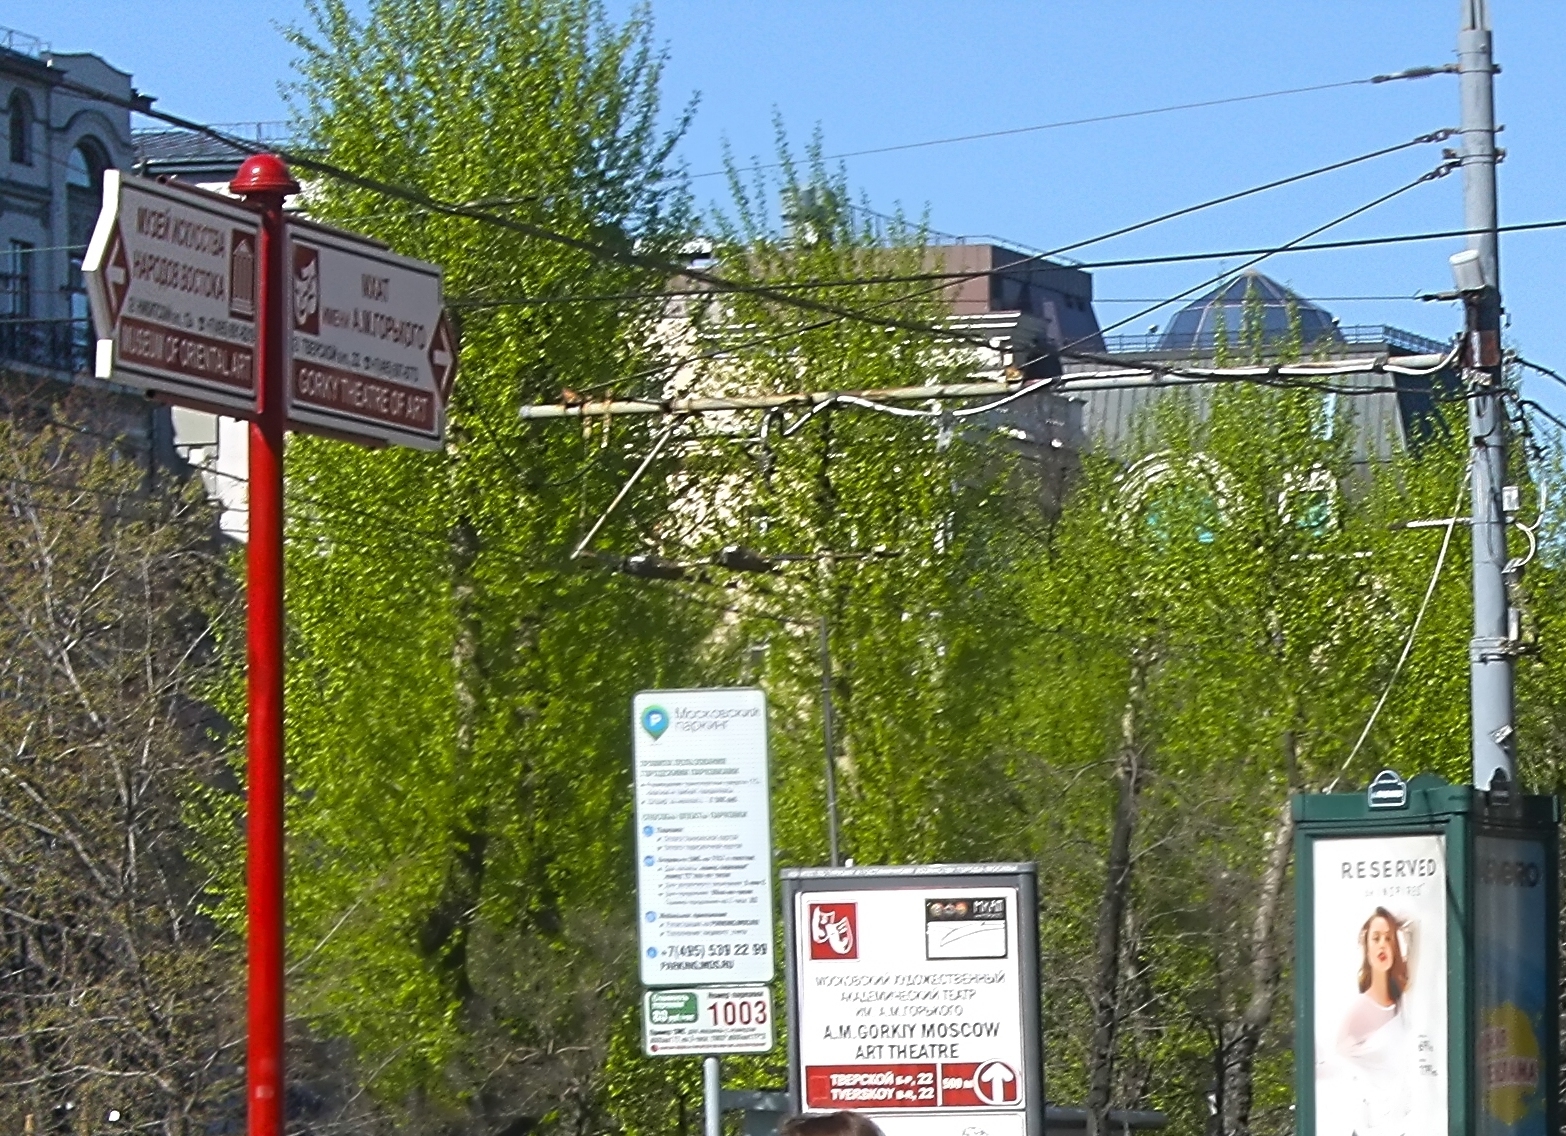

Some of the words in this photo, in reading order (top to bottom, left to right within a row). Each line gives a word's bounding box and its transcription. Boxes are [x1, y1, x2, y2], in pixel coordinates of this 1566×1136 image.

[298, 366, 338, 402] GORKY
[339, 378, 389, 413] THEATRE
[391, 389, 405, 416] OF
[406, 395, 429, 421] ART
[675, 706, 760, 720] Московский
[675, 719, 729, 733] паркинг
[1341, 858, 1437, 879] RESERVED
[815, 971, 892, 987] МОСКОВСКИЙ
[893, 970, 1006, 986] ХУДОЖЕСТВЕННЫЙ
[840, 988, 940, 1003] АКАДЕМИЧЕСКИЙ
[942, 988, 977, 1001] ТЕАТР
[707, 1000, 767, 1026] 1003
[921, 1021, 1001, 1039] MOSCOW
[855, 1045, 885, 1060] ART
[887, 1043, 961, 1060] THEATRE
[829, 1071, 894, 1087] ТВЕРСКОЙ
[917, 1072, 934, 1086] 22
[917, 1087, 935, 1101] 22
